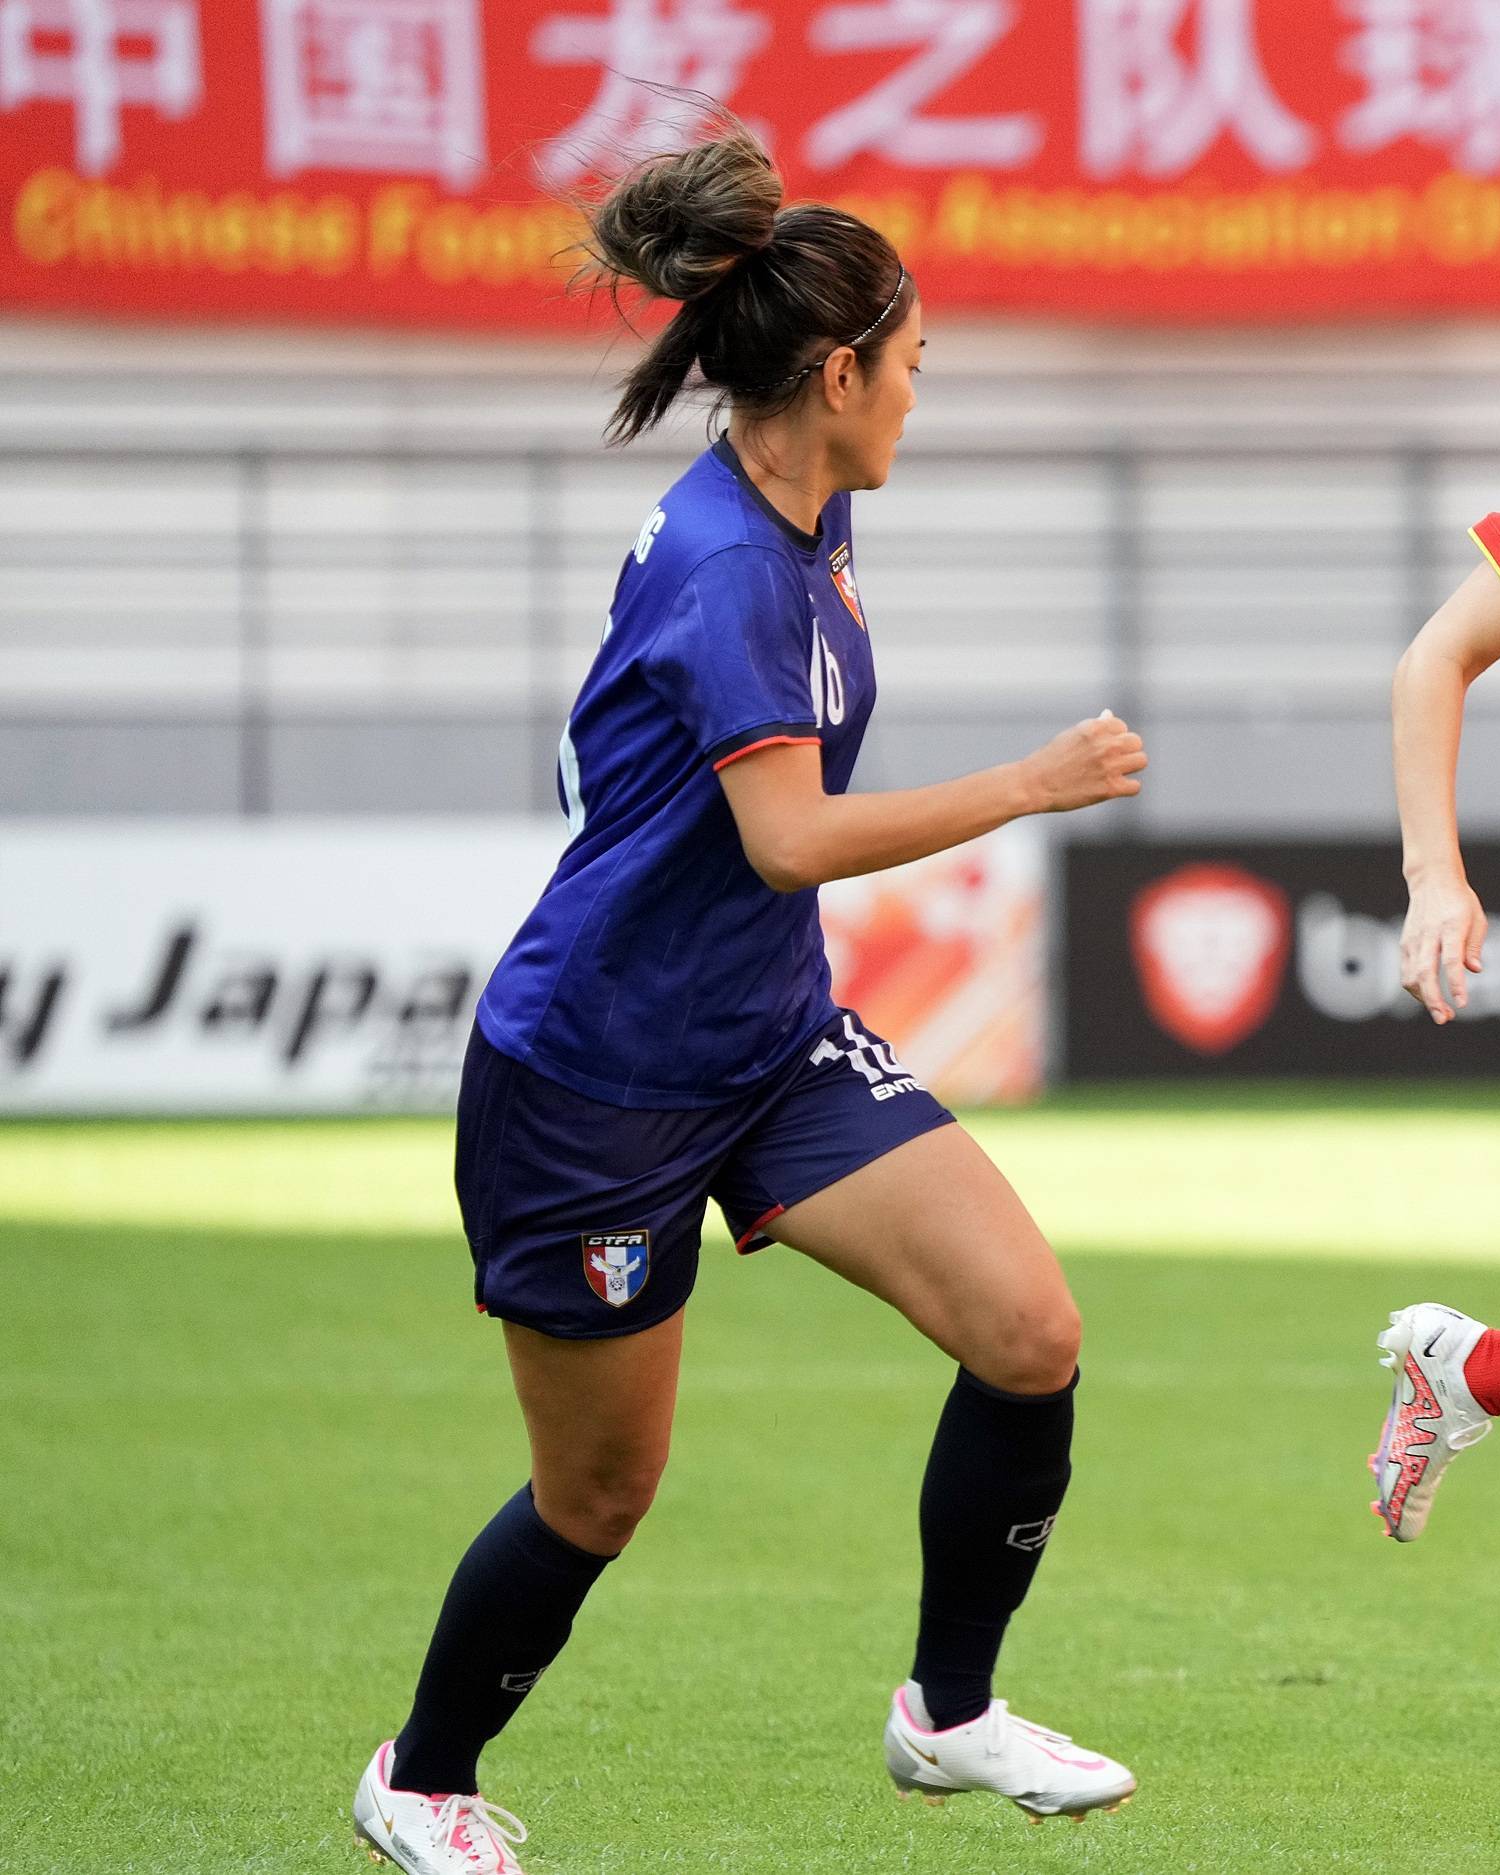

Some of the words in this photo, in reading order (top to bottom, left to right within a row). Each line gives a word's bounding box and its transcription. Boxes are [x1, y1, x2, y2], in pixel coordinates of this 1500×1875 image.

[16, 168, 356, 275] Chinese
[938, 173, 1399, 270] Association
[101, 918, 482, 1066] Japa
[588, 1235, 642, 1246] CTFA
